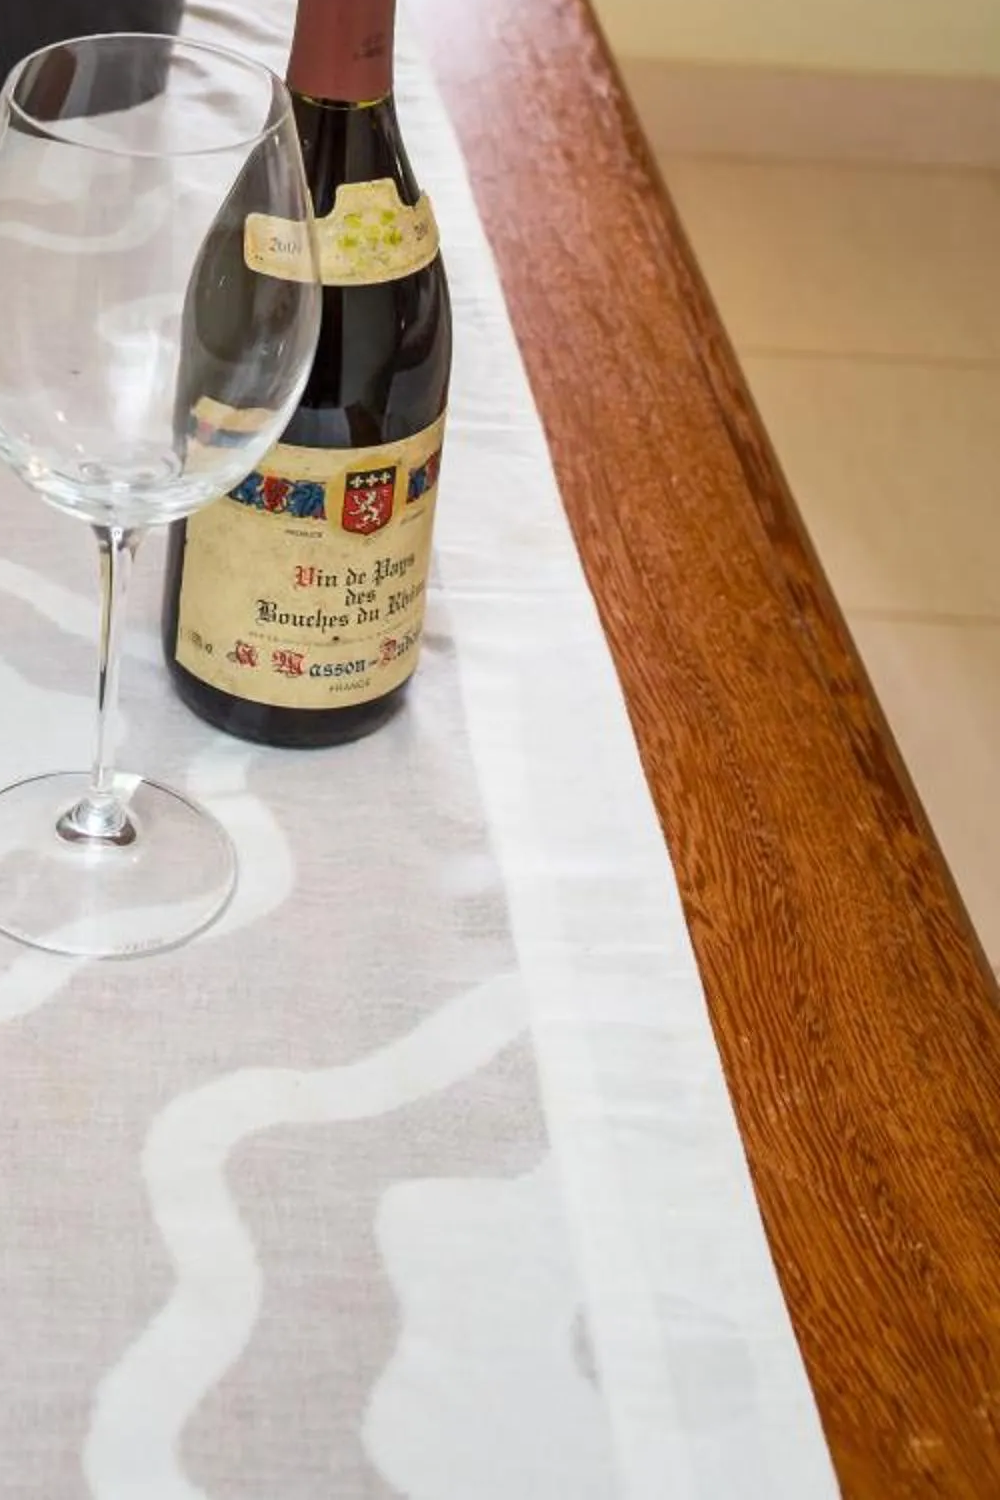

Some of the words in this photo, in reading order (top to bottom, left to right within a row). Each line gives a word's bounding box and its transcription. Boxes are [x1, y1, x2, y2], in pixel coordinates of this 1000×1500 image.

[294, 565, 337, 590] Vin
[345, 568, 367, 586] de
[344, 588, 376, 607] des
[255, 599, 349, 634] Bouches
[357, 607, 379, 625] du
